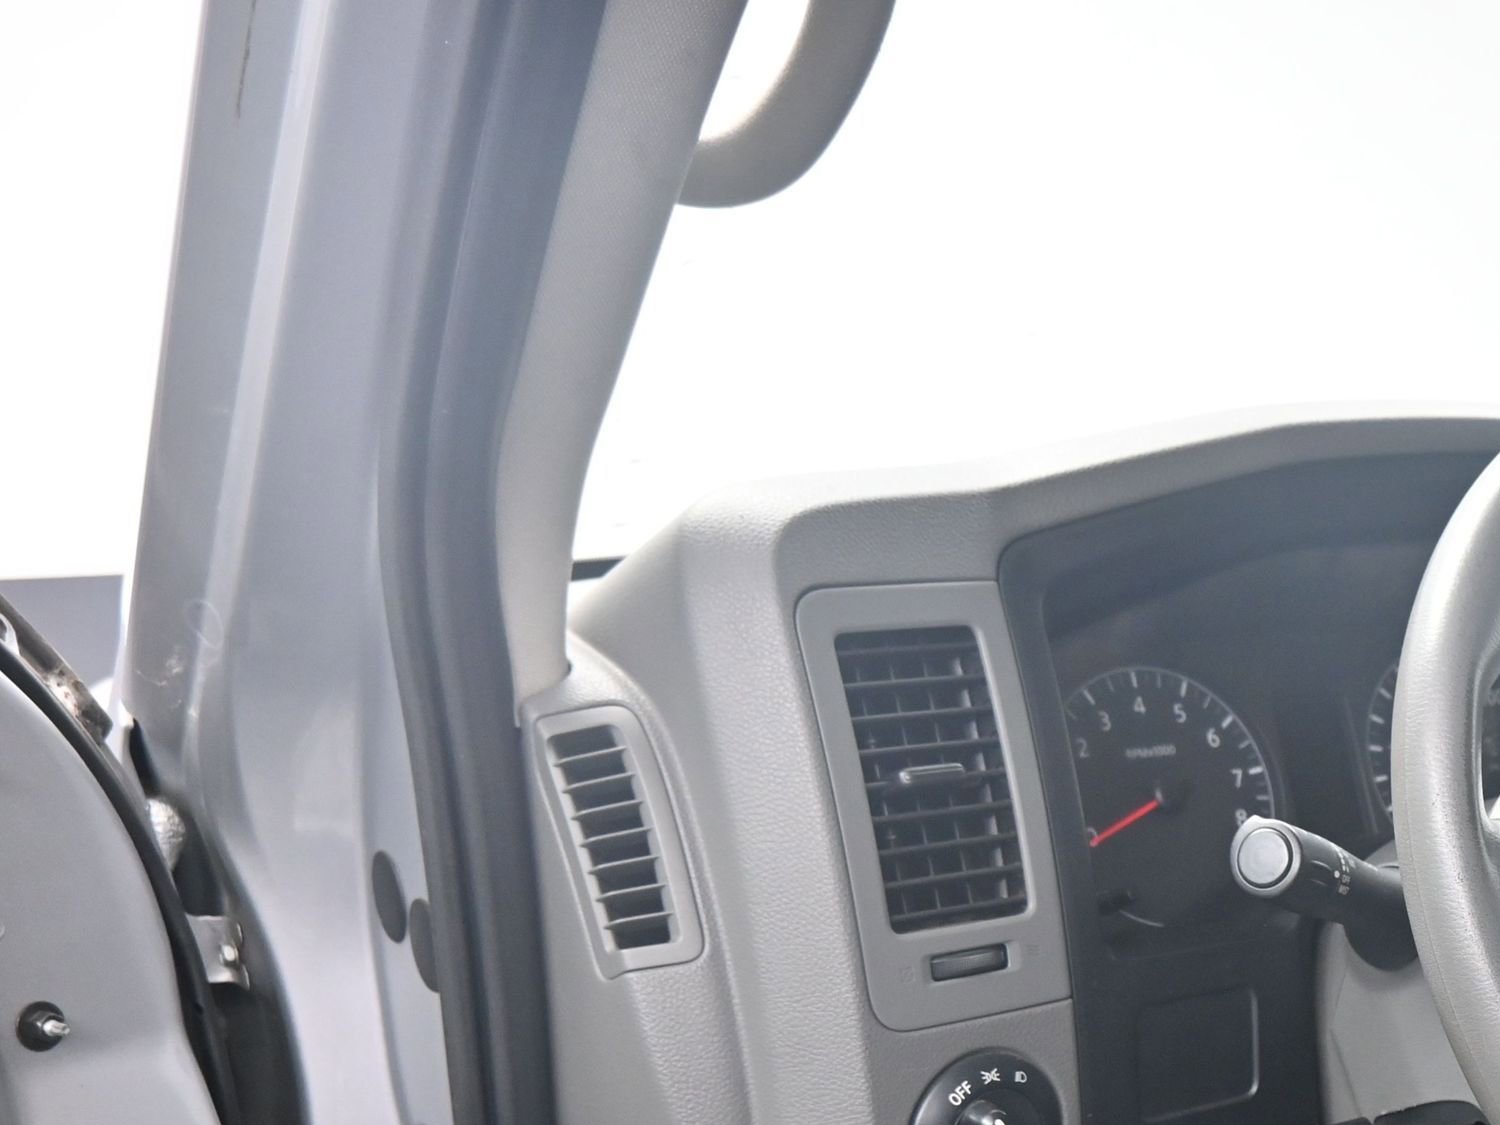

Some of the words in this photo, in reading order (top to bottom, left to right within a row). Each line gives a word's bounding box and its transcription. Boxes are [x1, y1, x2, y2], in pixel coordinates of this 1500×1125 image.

[1131, 695, 1147, 715] 4
[1172, 701, 1188, 724] 5
[1096, 709, 1113, 732] 3
[1074, 736, 1091, 759] 2
[1205, 726, 1221, 749] 6
[1229, 767, 1244, 789] 7
[947, 1079, 973, 1107] OFF
